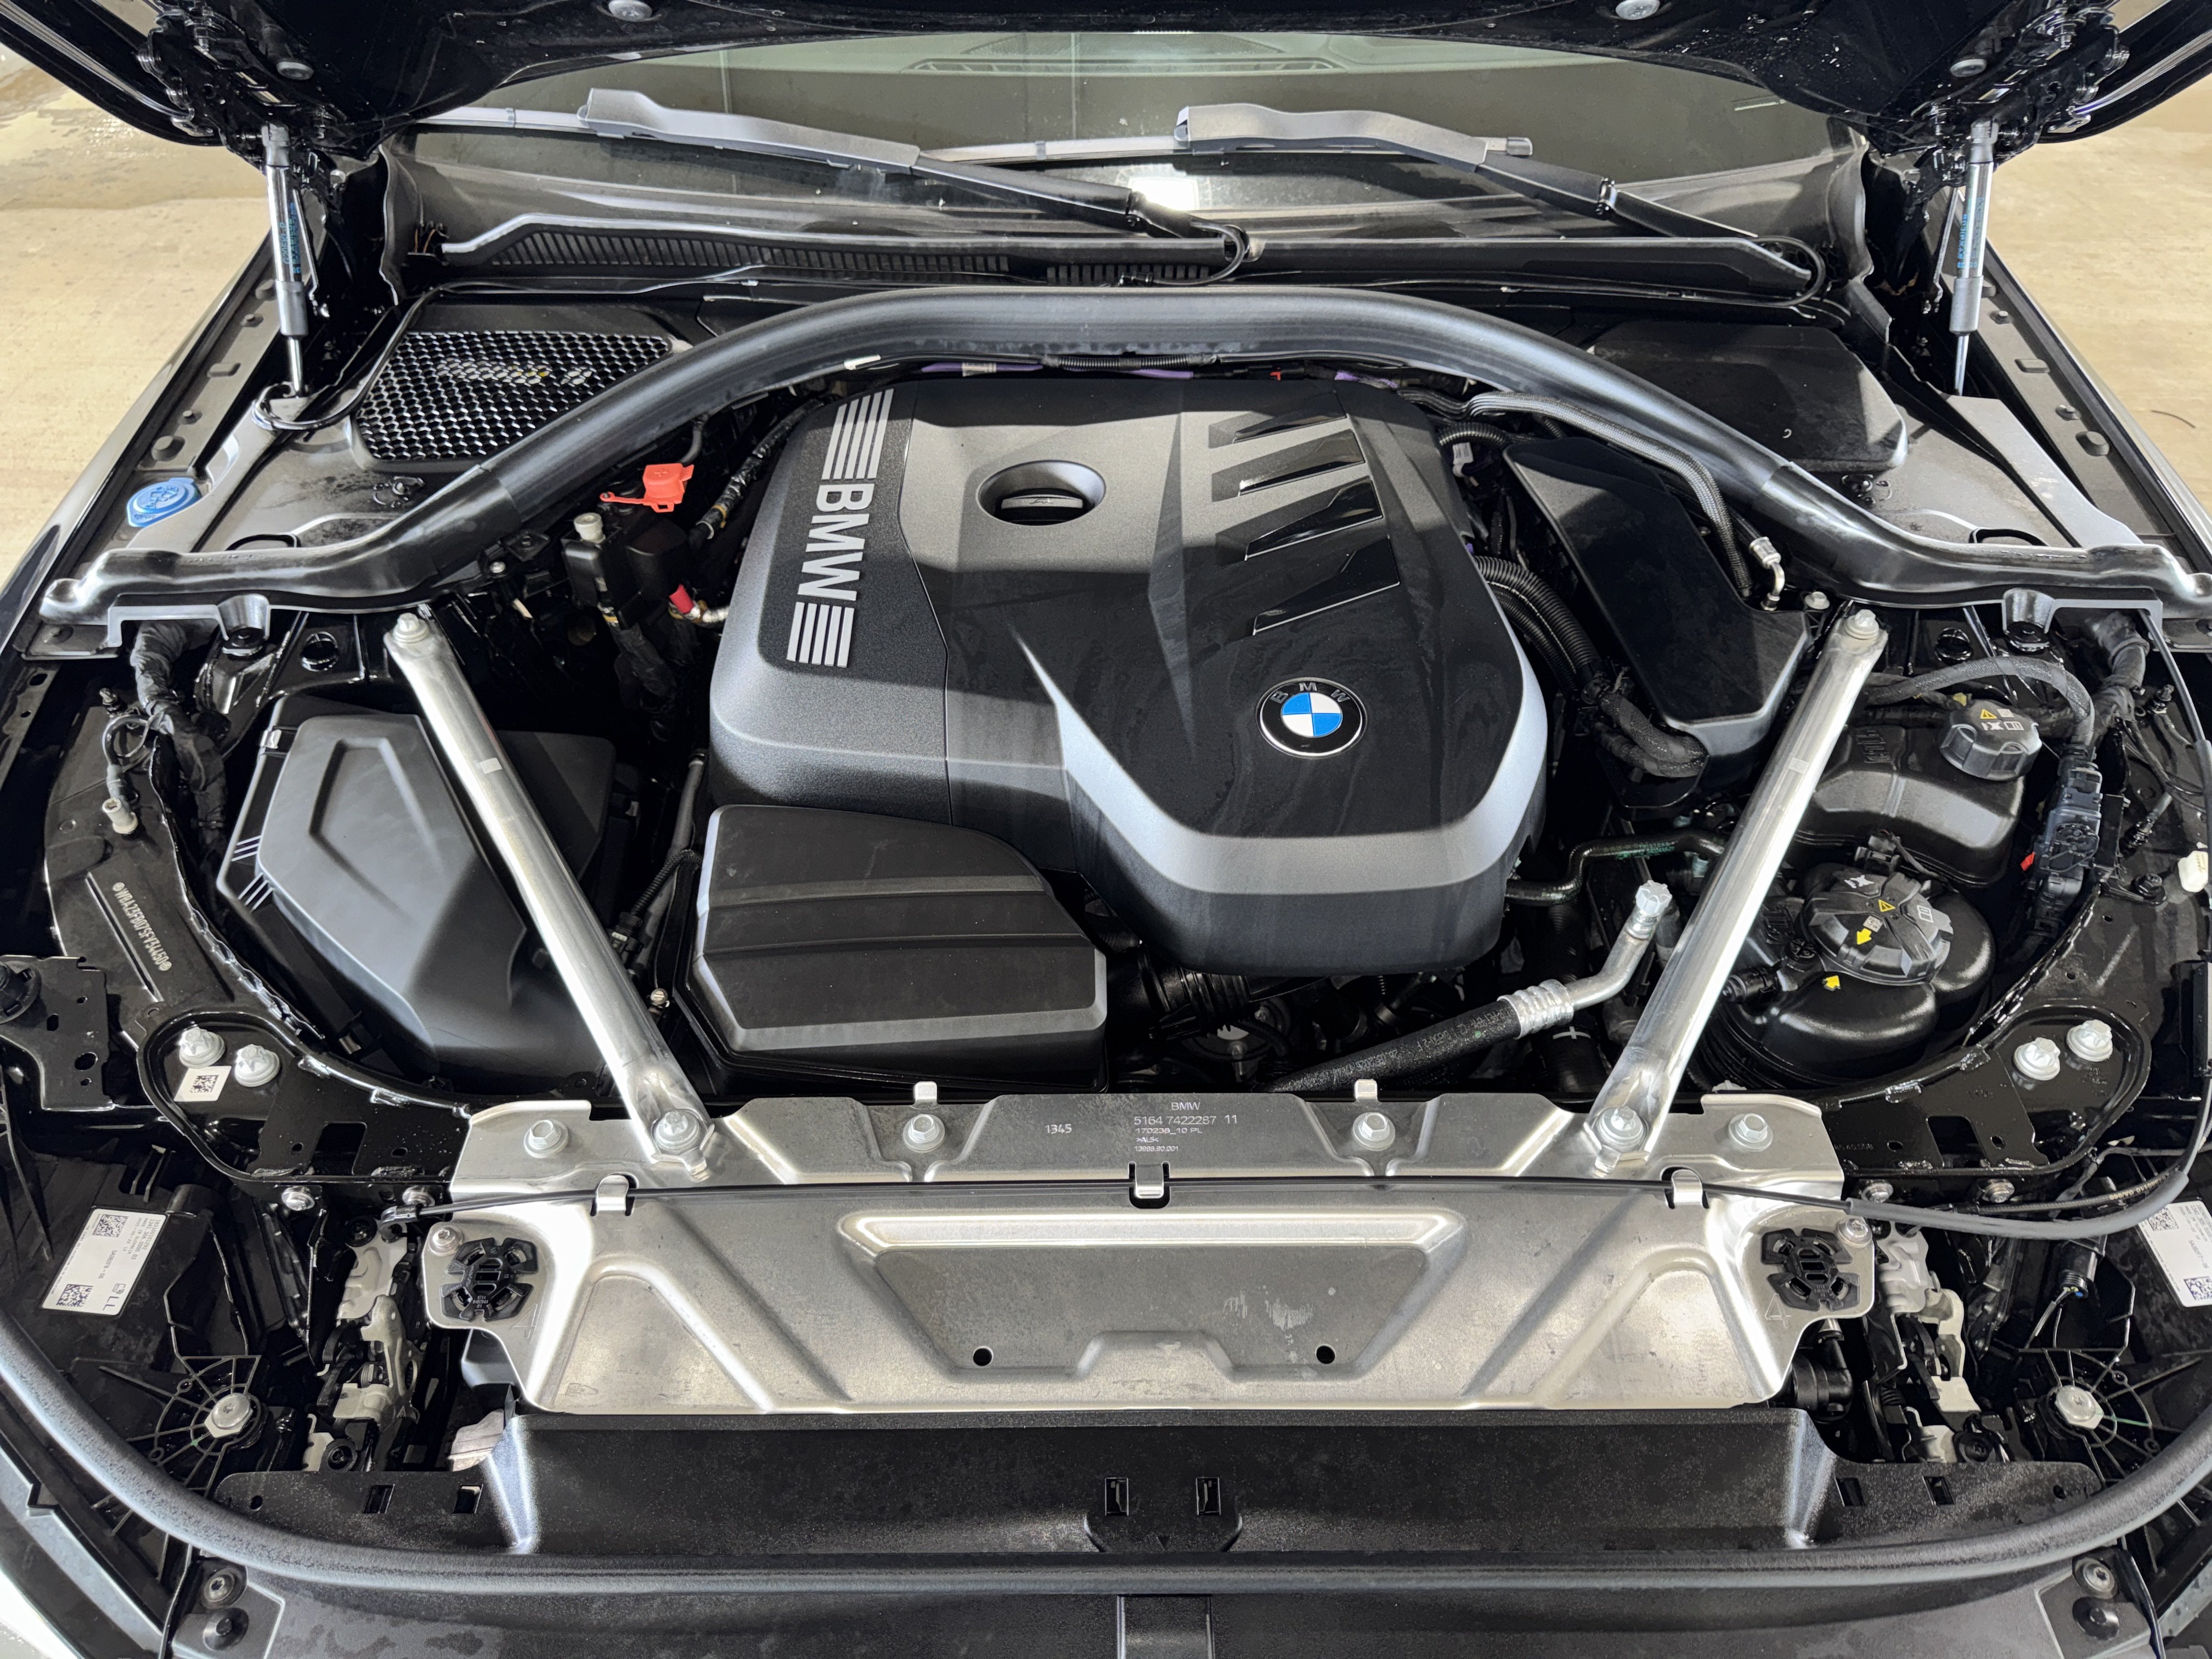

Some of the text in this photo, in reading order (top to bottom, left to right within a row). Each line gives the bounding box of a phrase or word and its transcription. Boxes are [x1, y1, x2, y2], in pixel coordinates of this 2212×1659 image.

[797, 484, 874, 601] BMW
[1270, 682, 1350, 704] BMW
[1171, 1102, 1201, 1110] BMW
[1134, 1114, 1237, 1125] 5164 7422287 11
[1045, 1124, 1072, 1135] 1345
